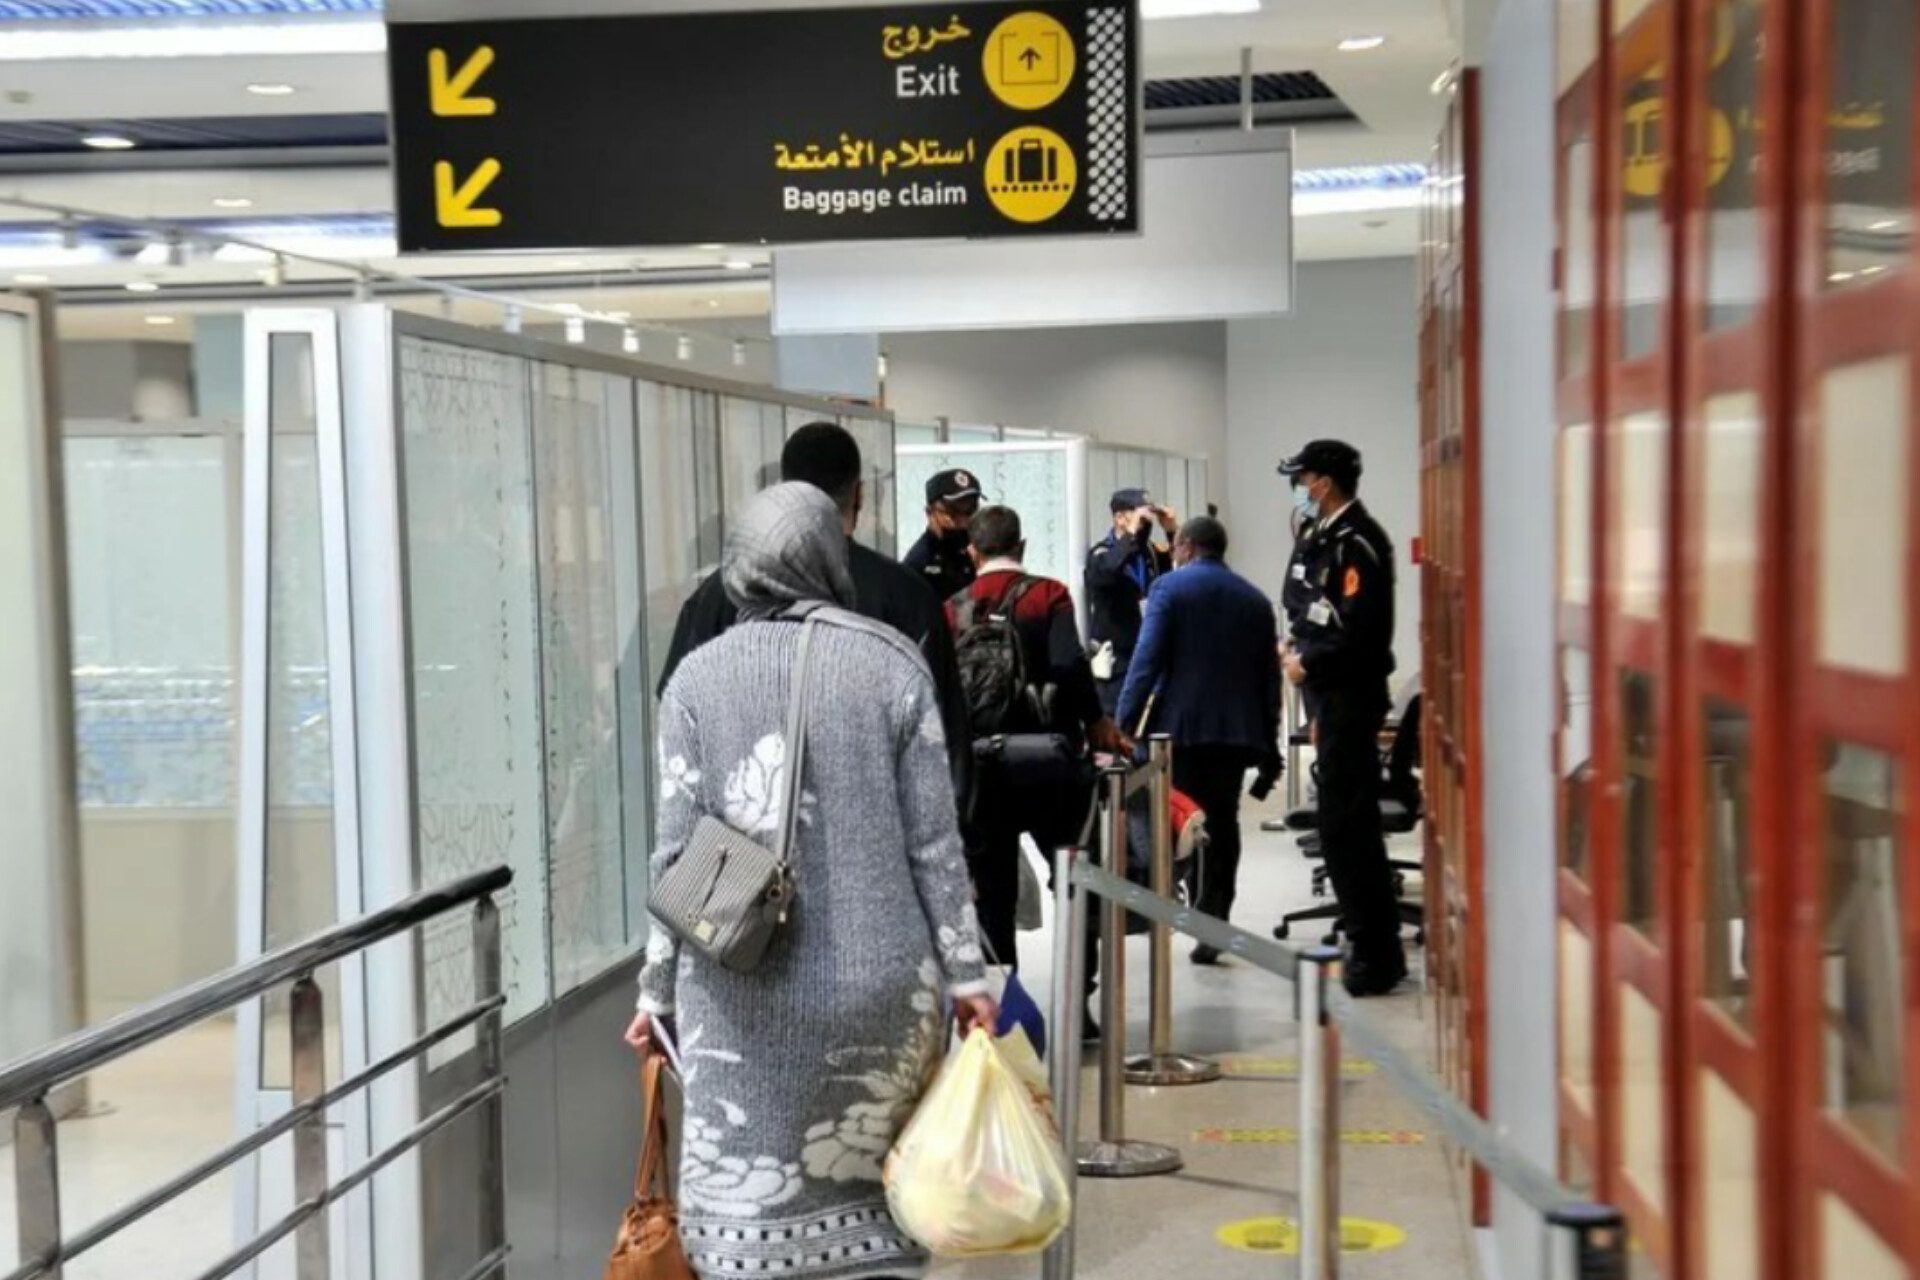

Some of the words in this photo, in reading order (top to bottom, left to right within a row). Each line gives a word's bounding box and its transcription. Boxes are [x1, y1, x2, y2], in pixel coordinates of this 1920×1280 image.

[882, 15, 971, 59] خروج
[896, 64, 959, 98] Exit
[774, 132, 876, 170] الأمتعة
[880, 138, 975, 176] استلام
[783, 185, 892, 215] Baggage
[898, 181, 967, 207] claim
